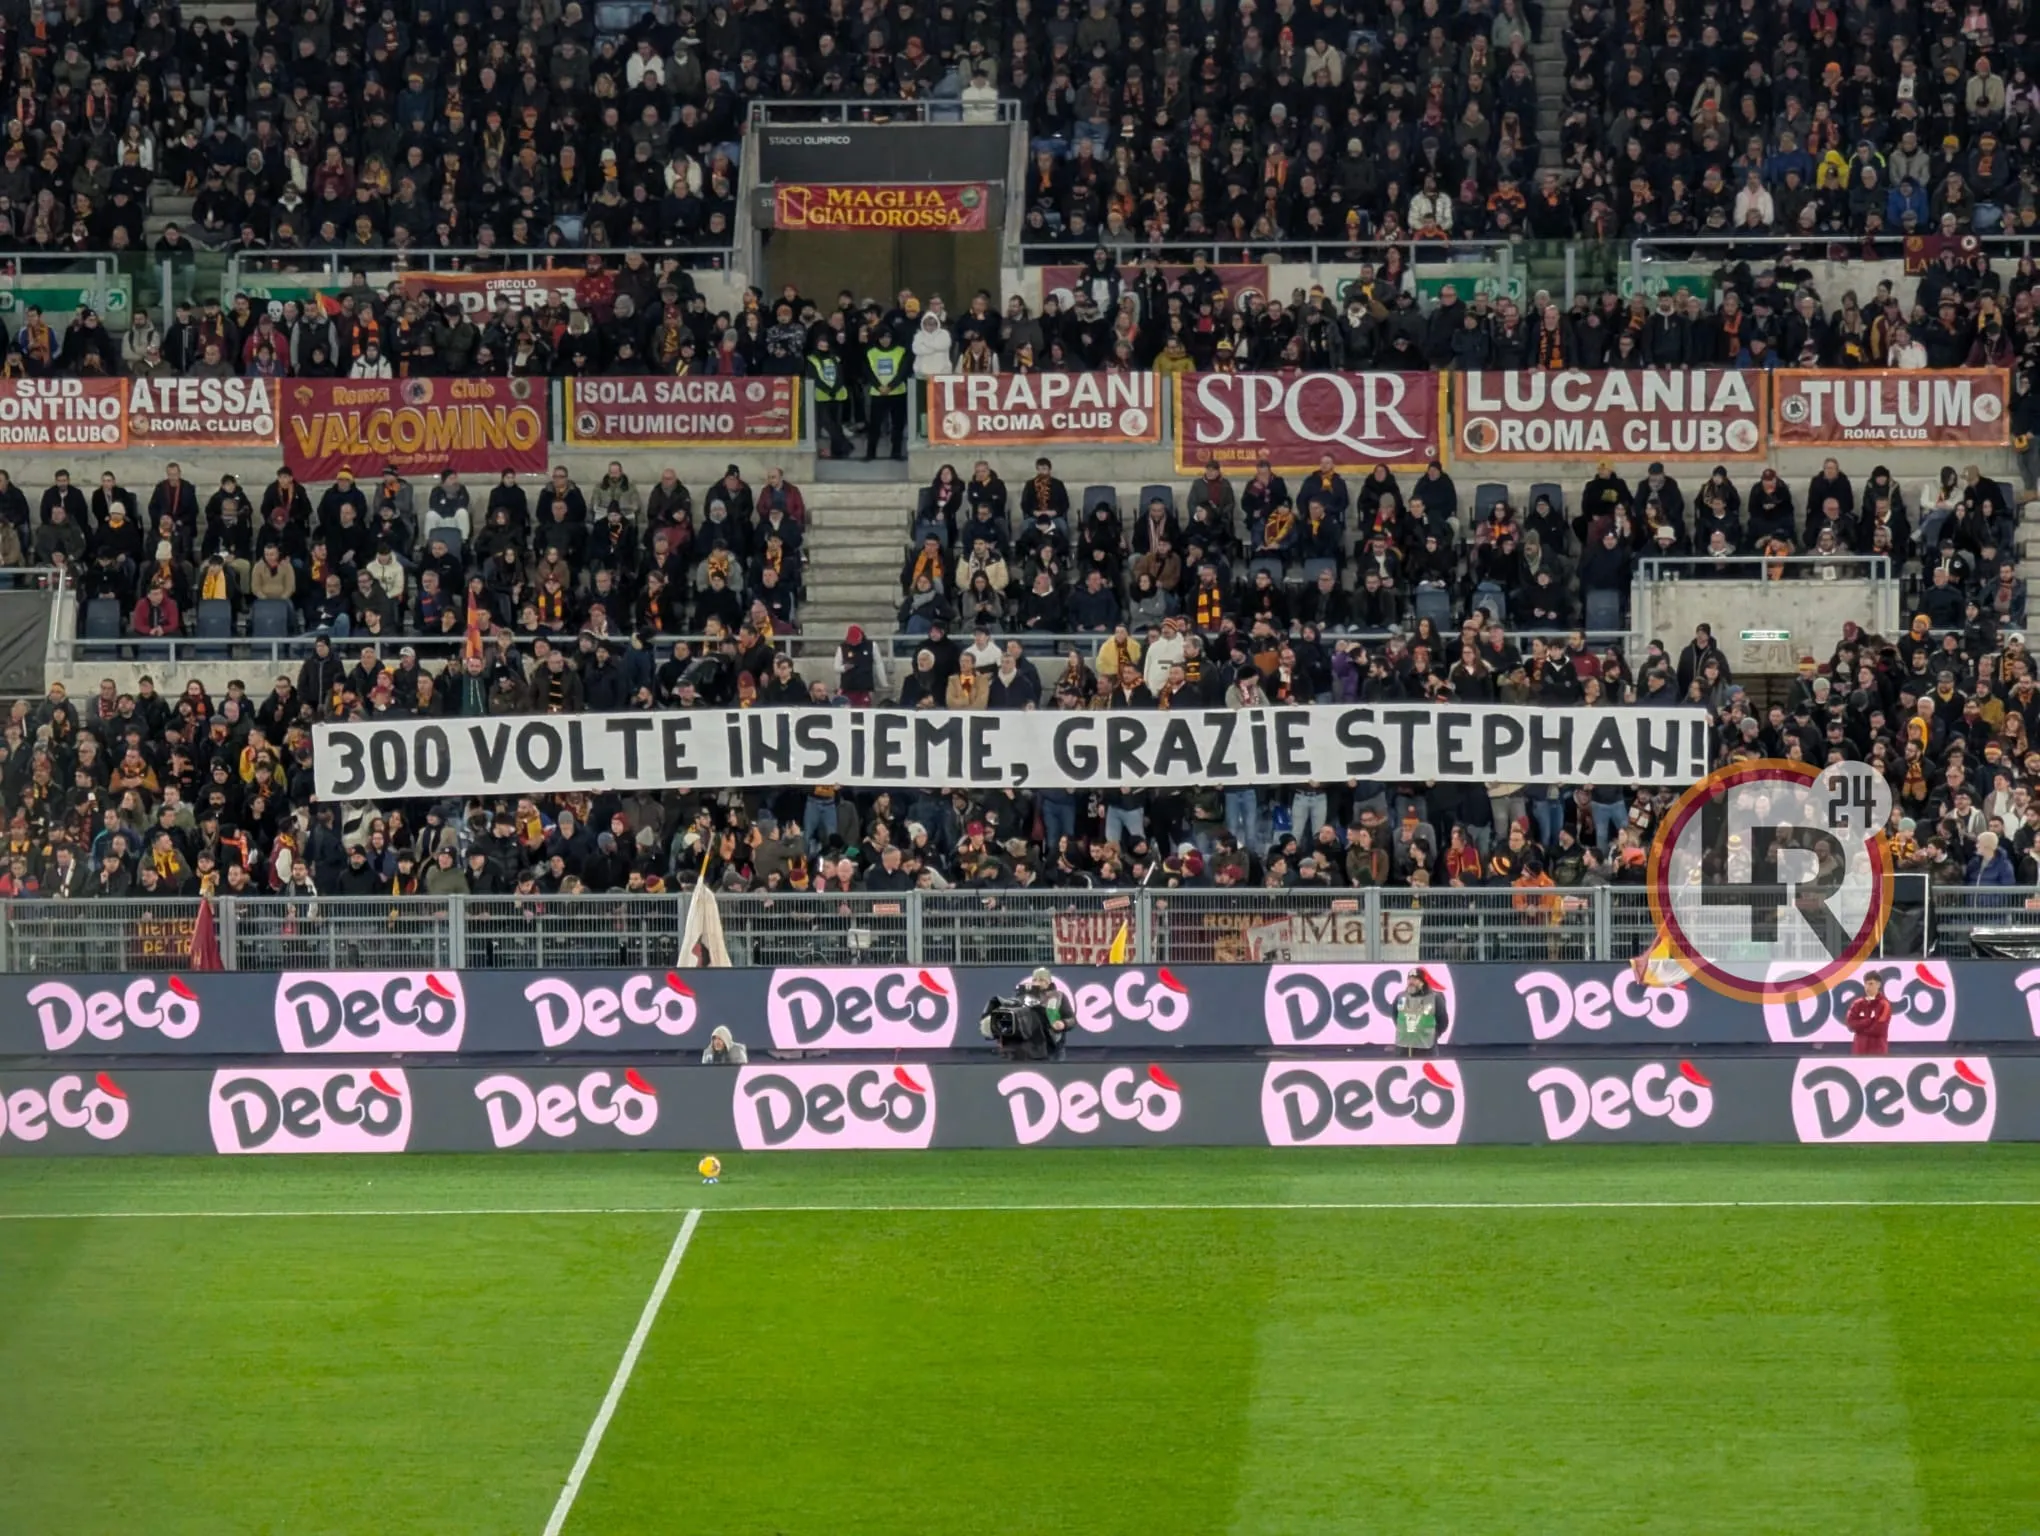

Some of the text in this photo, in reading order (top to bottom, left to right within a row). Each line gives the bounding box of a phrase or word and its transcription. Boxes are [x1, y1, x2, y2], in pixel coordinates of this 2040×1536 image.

[768, 136, 850, 145] STADIO OLIMPICO
[827, 188, 945, 207] MAGLIA
[808, 207, 962, 226] GIALLOROSSA
[486, 279, 537, 290] CIRCOLO
[16, 379, 82, 397] SUD
[129, 378, 272, 414] ATESSA
[576, 381, 737, 403] ISOLA SACRA
[934, 372, 1153, 411] TRAPANI
[1467, 370, 1755, 412] LUCANIA
[1801, 380, 1971, 427] TULUM
[151, 418, 253, 432] ROMA CLUB
[605, 414, 734, 434] FIUMICINO
[977, 412, 1113, 431] ROMA CLUB
[1196, 373, 1426, 457] SPQR
[0, 425, 101, 443] ROMA CLUB
[290, 404, 542, 459] VALCOMINO
[1501, 419, 1724, 451] ROMA CLUB
[1844, 428, 1928, 440] ROMA CLUB
[327, 724, 450, 795] 300
[468, 716, 698, 784] VOLTE
[0, 1071, 129, 1142] ecò
